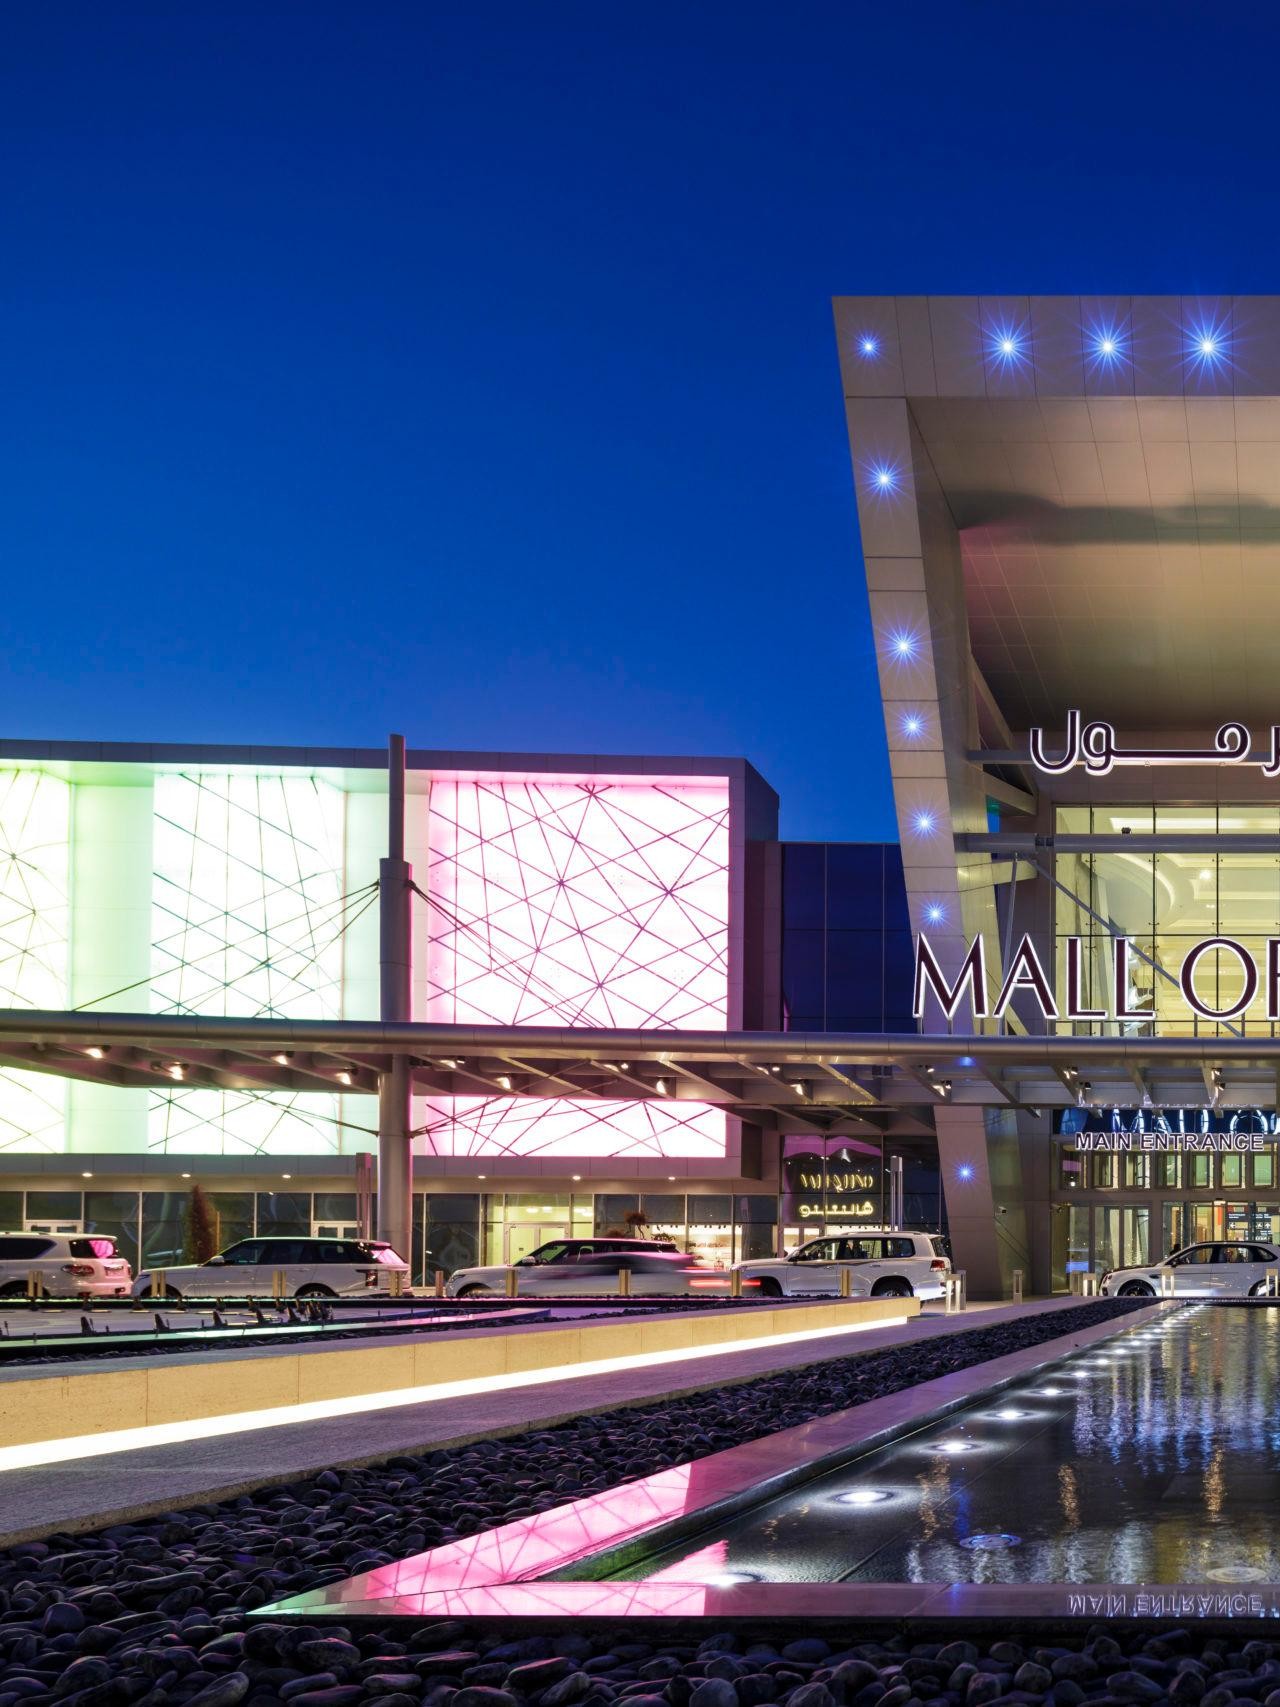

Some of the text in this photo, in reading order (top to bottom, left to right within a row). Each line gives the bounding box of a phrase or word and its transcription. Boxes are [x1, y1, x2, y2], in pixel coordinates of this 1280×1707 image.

[912, 932, 1156, 1021] MALL
[1075, 1132, 1265, 1151] MAIN ENTRANCE
